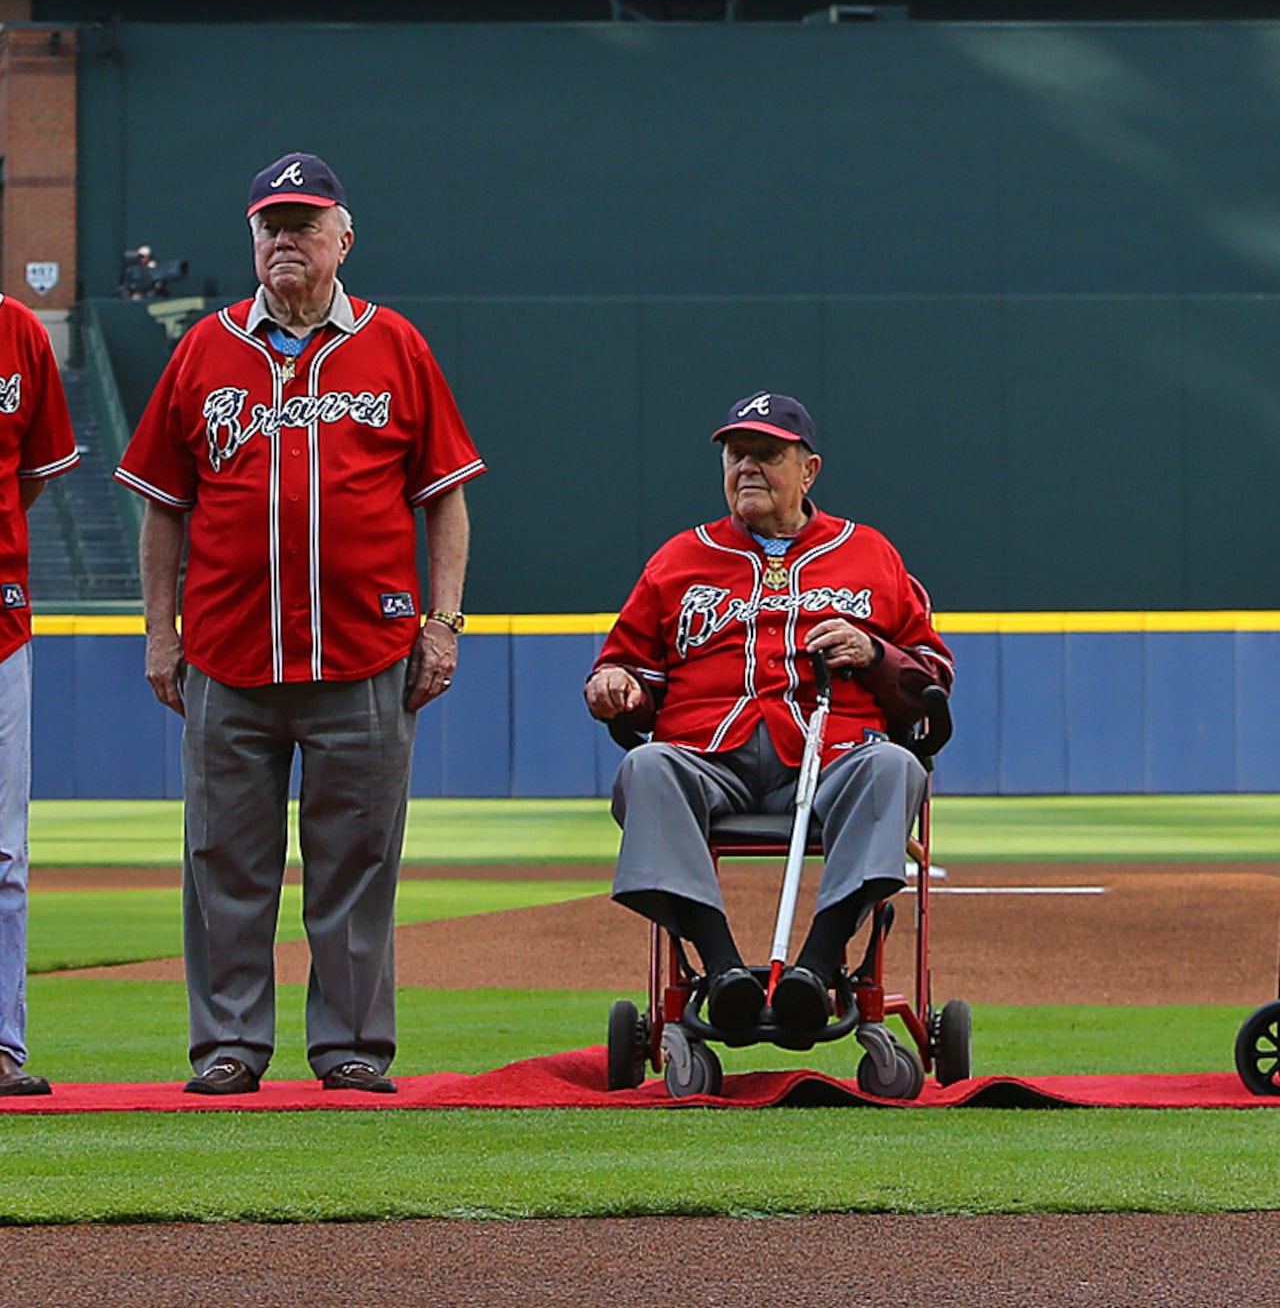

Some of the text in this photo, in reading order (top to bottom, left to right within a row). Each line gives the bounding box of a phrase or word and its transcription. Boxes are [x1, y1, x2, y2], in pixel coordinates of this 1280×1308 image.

[271, 160, 303, 188] A
[203, 387, 392, 473] Braves
[737, 392, 771, 418] A
[675, 584, 872, 660] Braves
